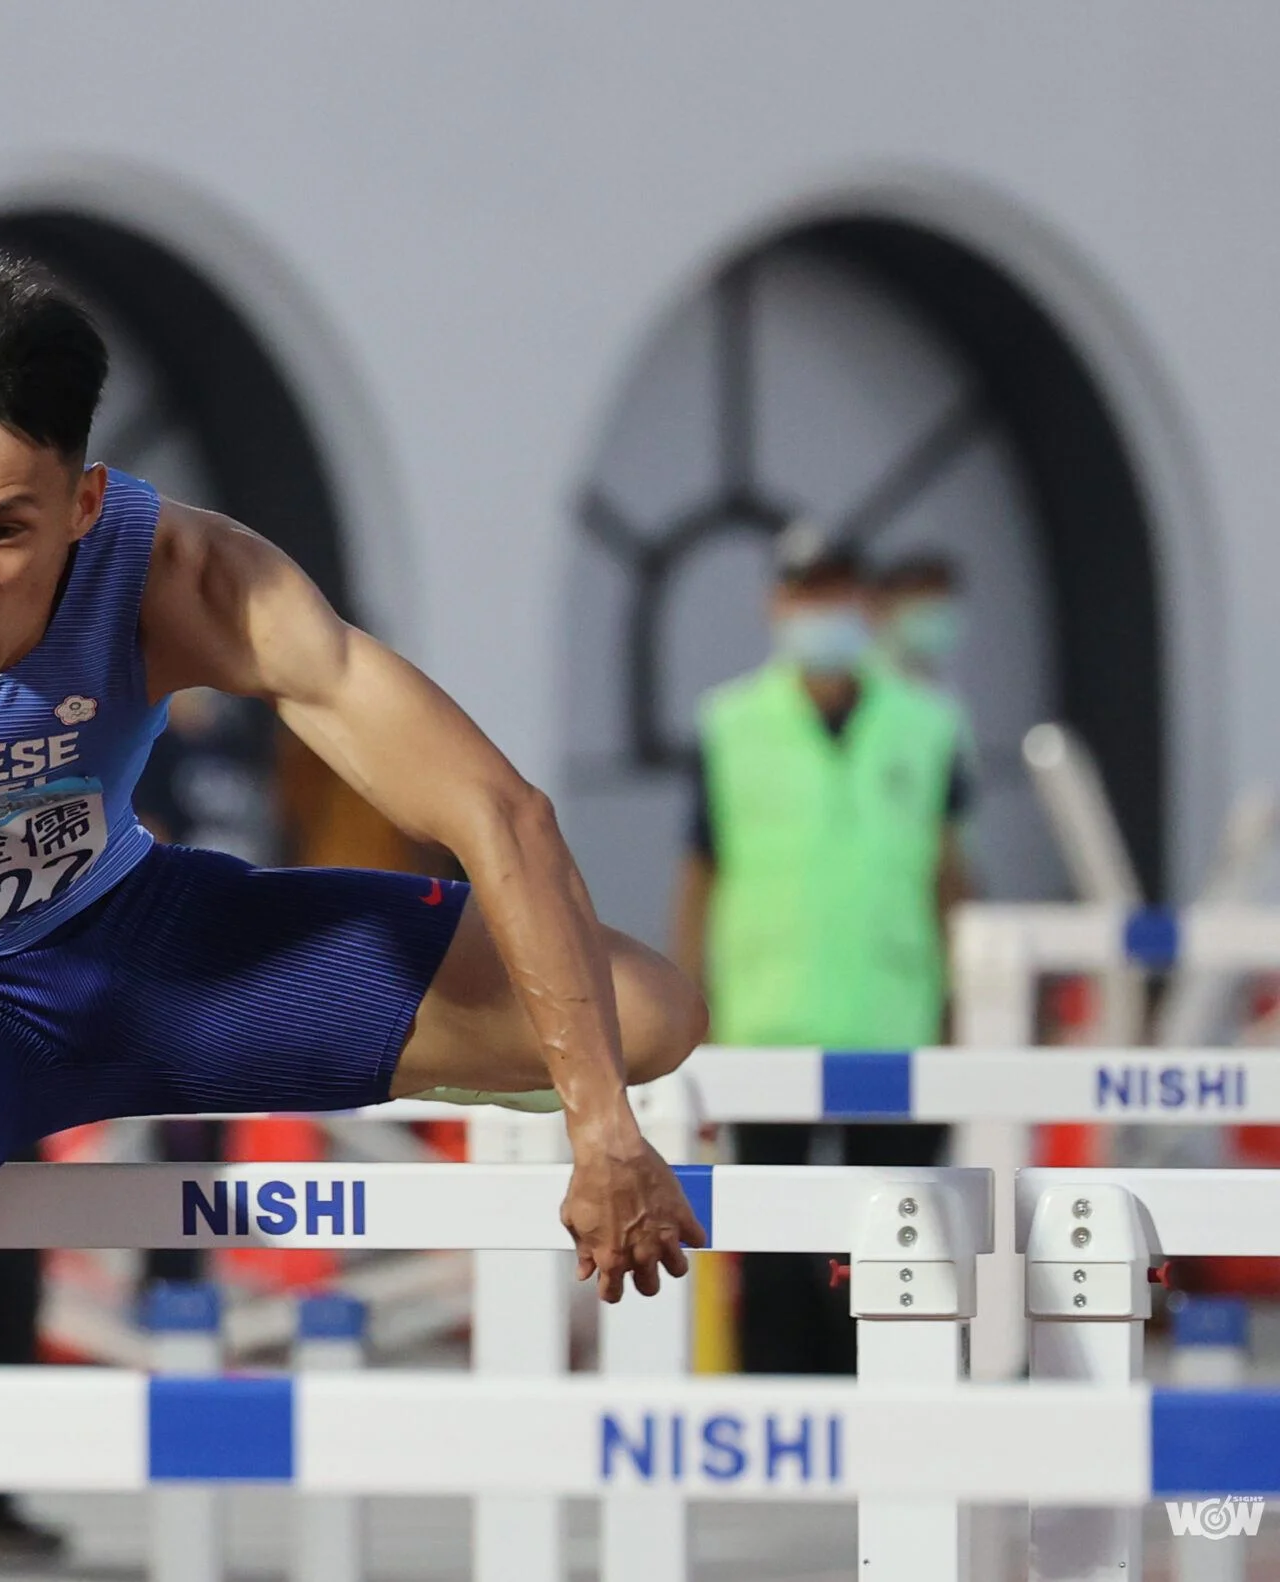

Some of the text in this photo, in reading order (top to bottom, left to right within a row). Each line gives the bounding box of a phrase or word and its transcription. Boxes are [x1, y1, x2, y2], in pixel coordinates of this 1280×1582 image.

[1095, 1066, 1246, 1108] NISHI
[182, 1180, 366, 1236] NISHI
[600, 1411, 842, 1481] NISHI
